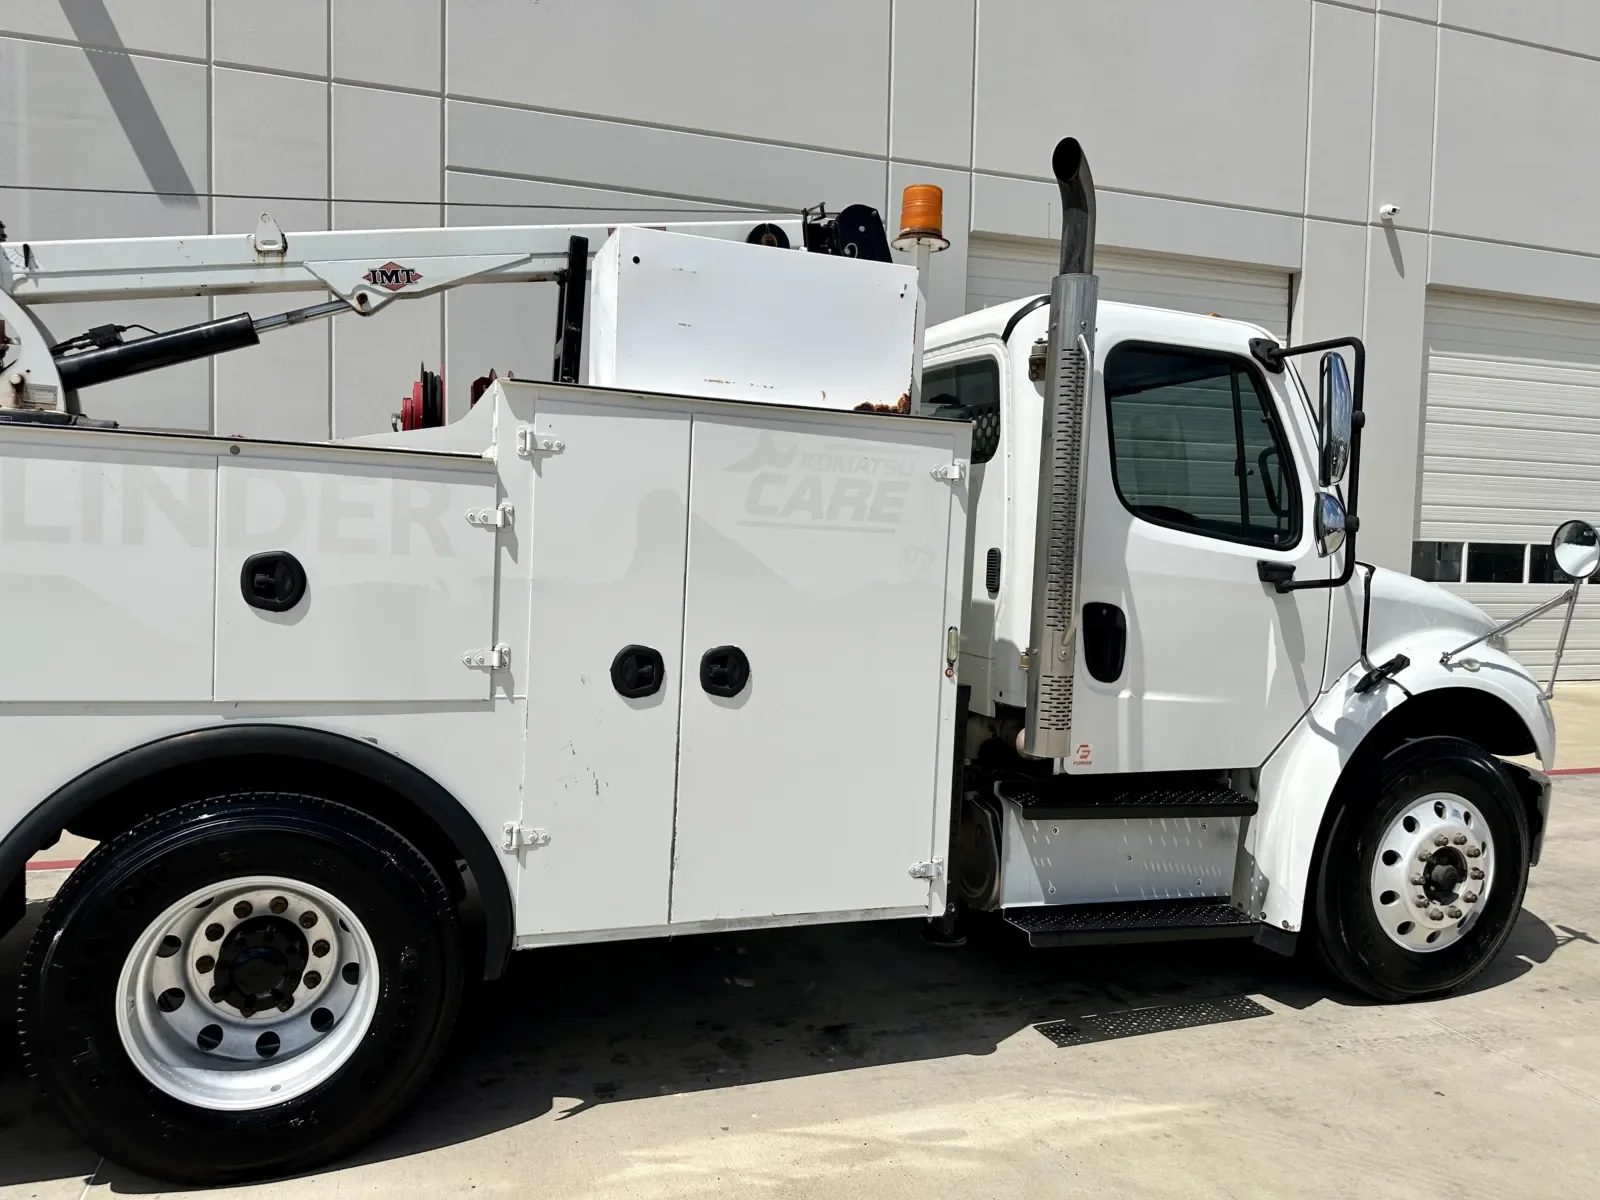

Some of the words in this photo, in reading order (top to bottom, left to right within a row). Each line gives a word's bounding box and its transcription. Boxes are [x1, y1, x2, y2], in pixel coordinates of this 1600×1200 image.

[369, 269, 415, 285] IMT
[799, 453, 917, 476] KOMATSU
[744, 472, 910, 524] CARE
